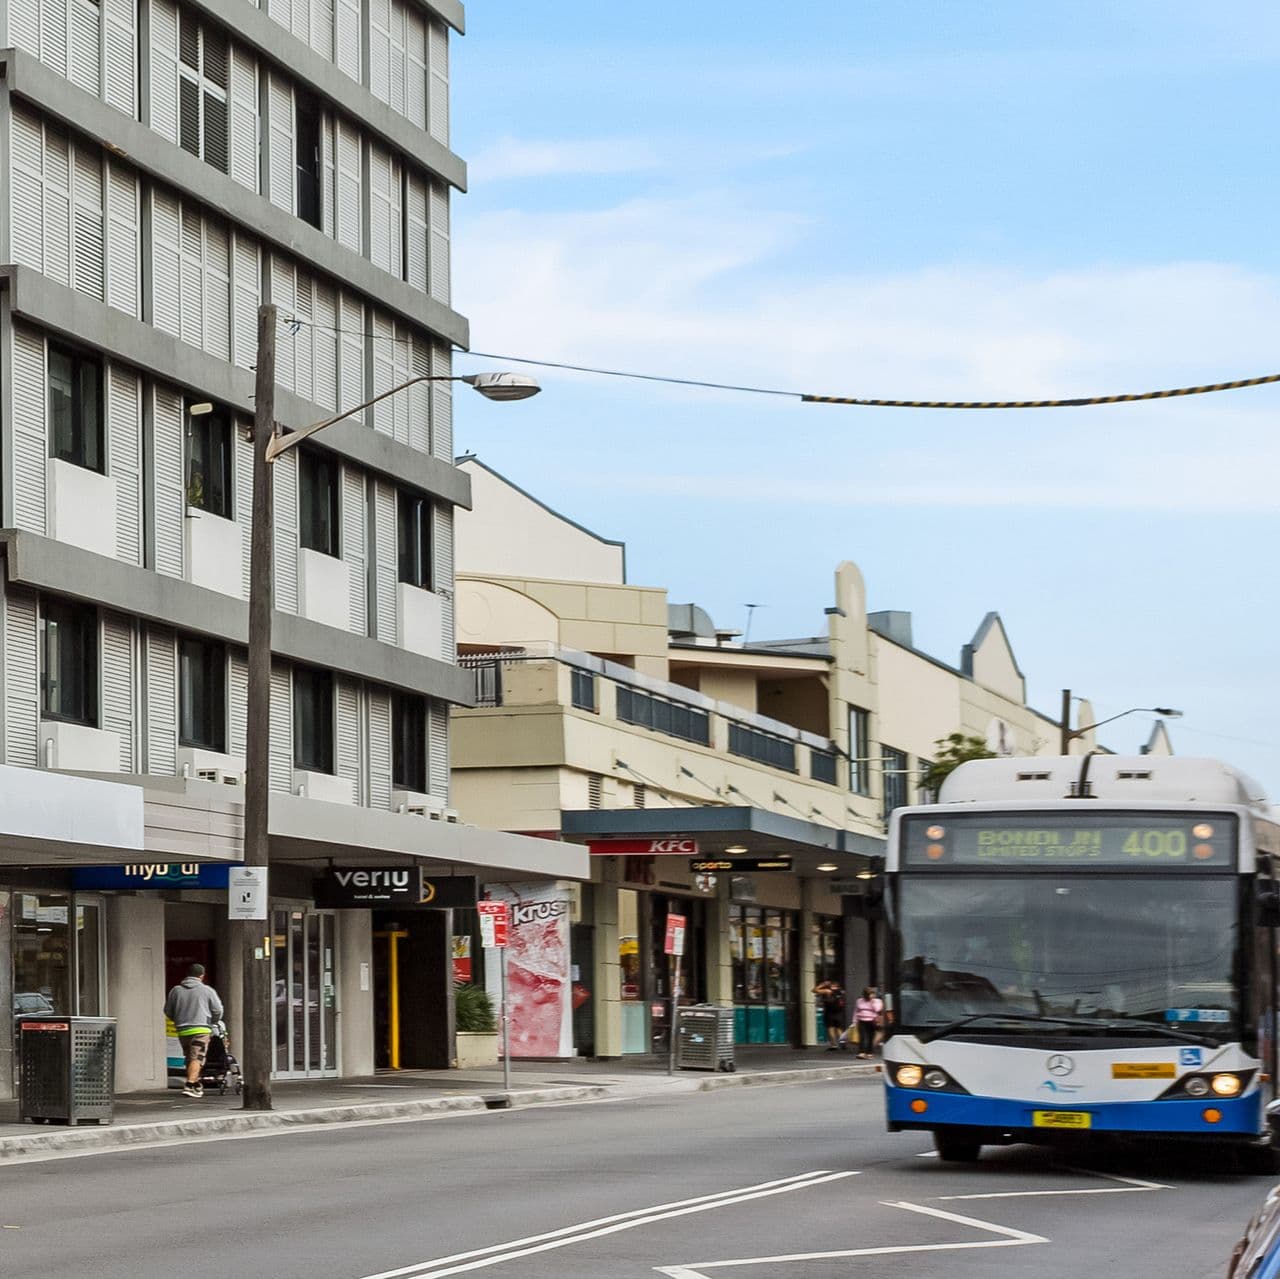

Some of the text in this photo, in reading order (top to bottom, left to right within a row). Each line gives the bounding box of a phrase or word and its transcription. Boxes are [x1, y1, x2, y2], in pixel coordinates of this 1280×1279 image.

[648, 840, 692, 852] KFC
[977, 830, 1060, 846] BONDI
[1122, 829, 1187, 857] 400
[1045, 846, 1102, 857] STOPS
[334, 870, 409, 888] veriu
